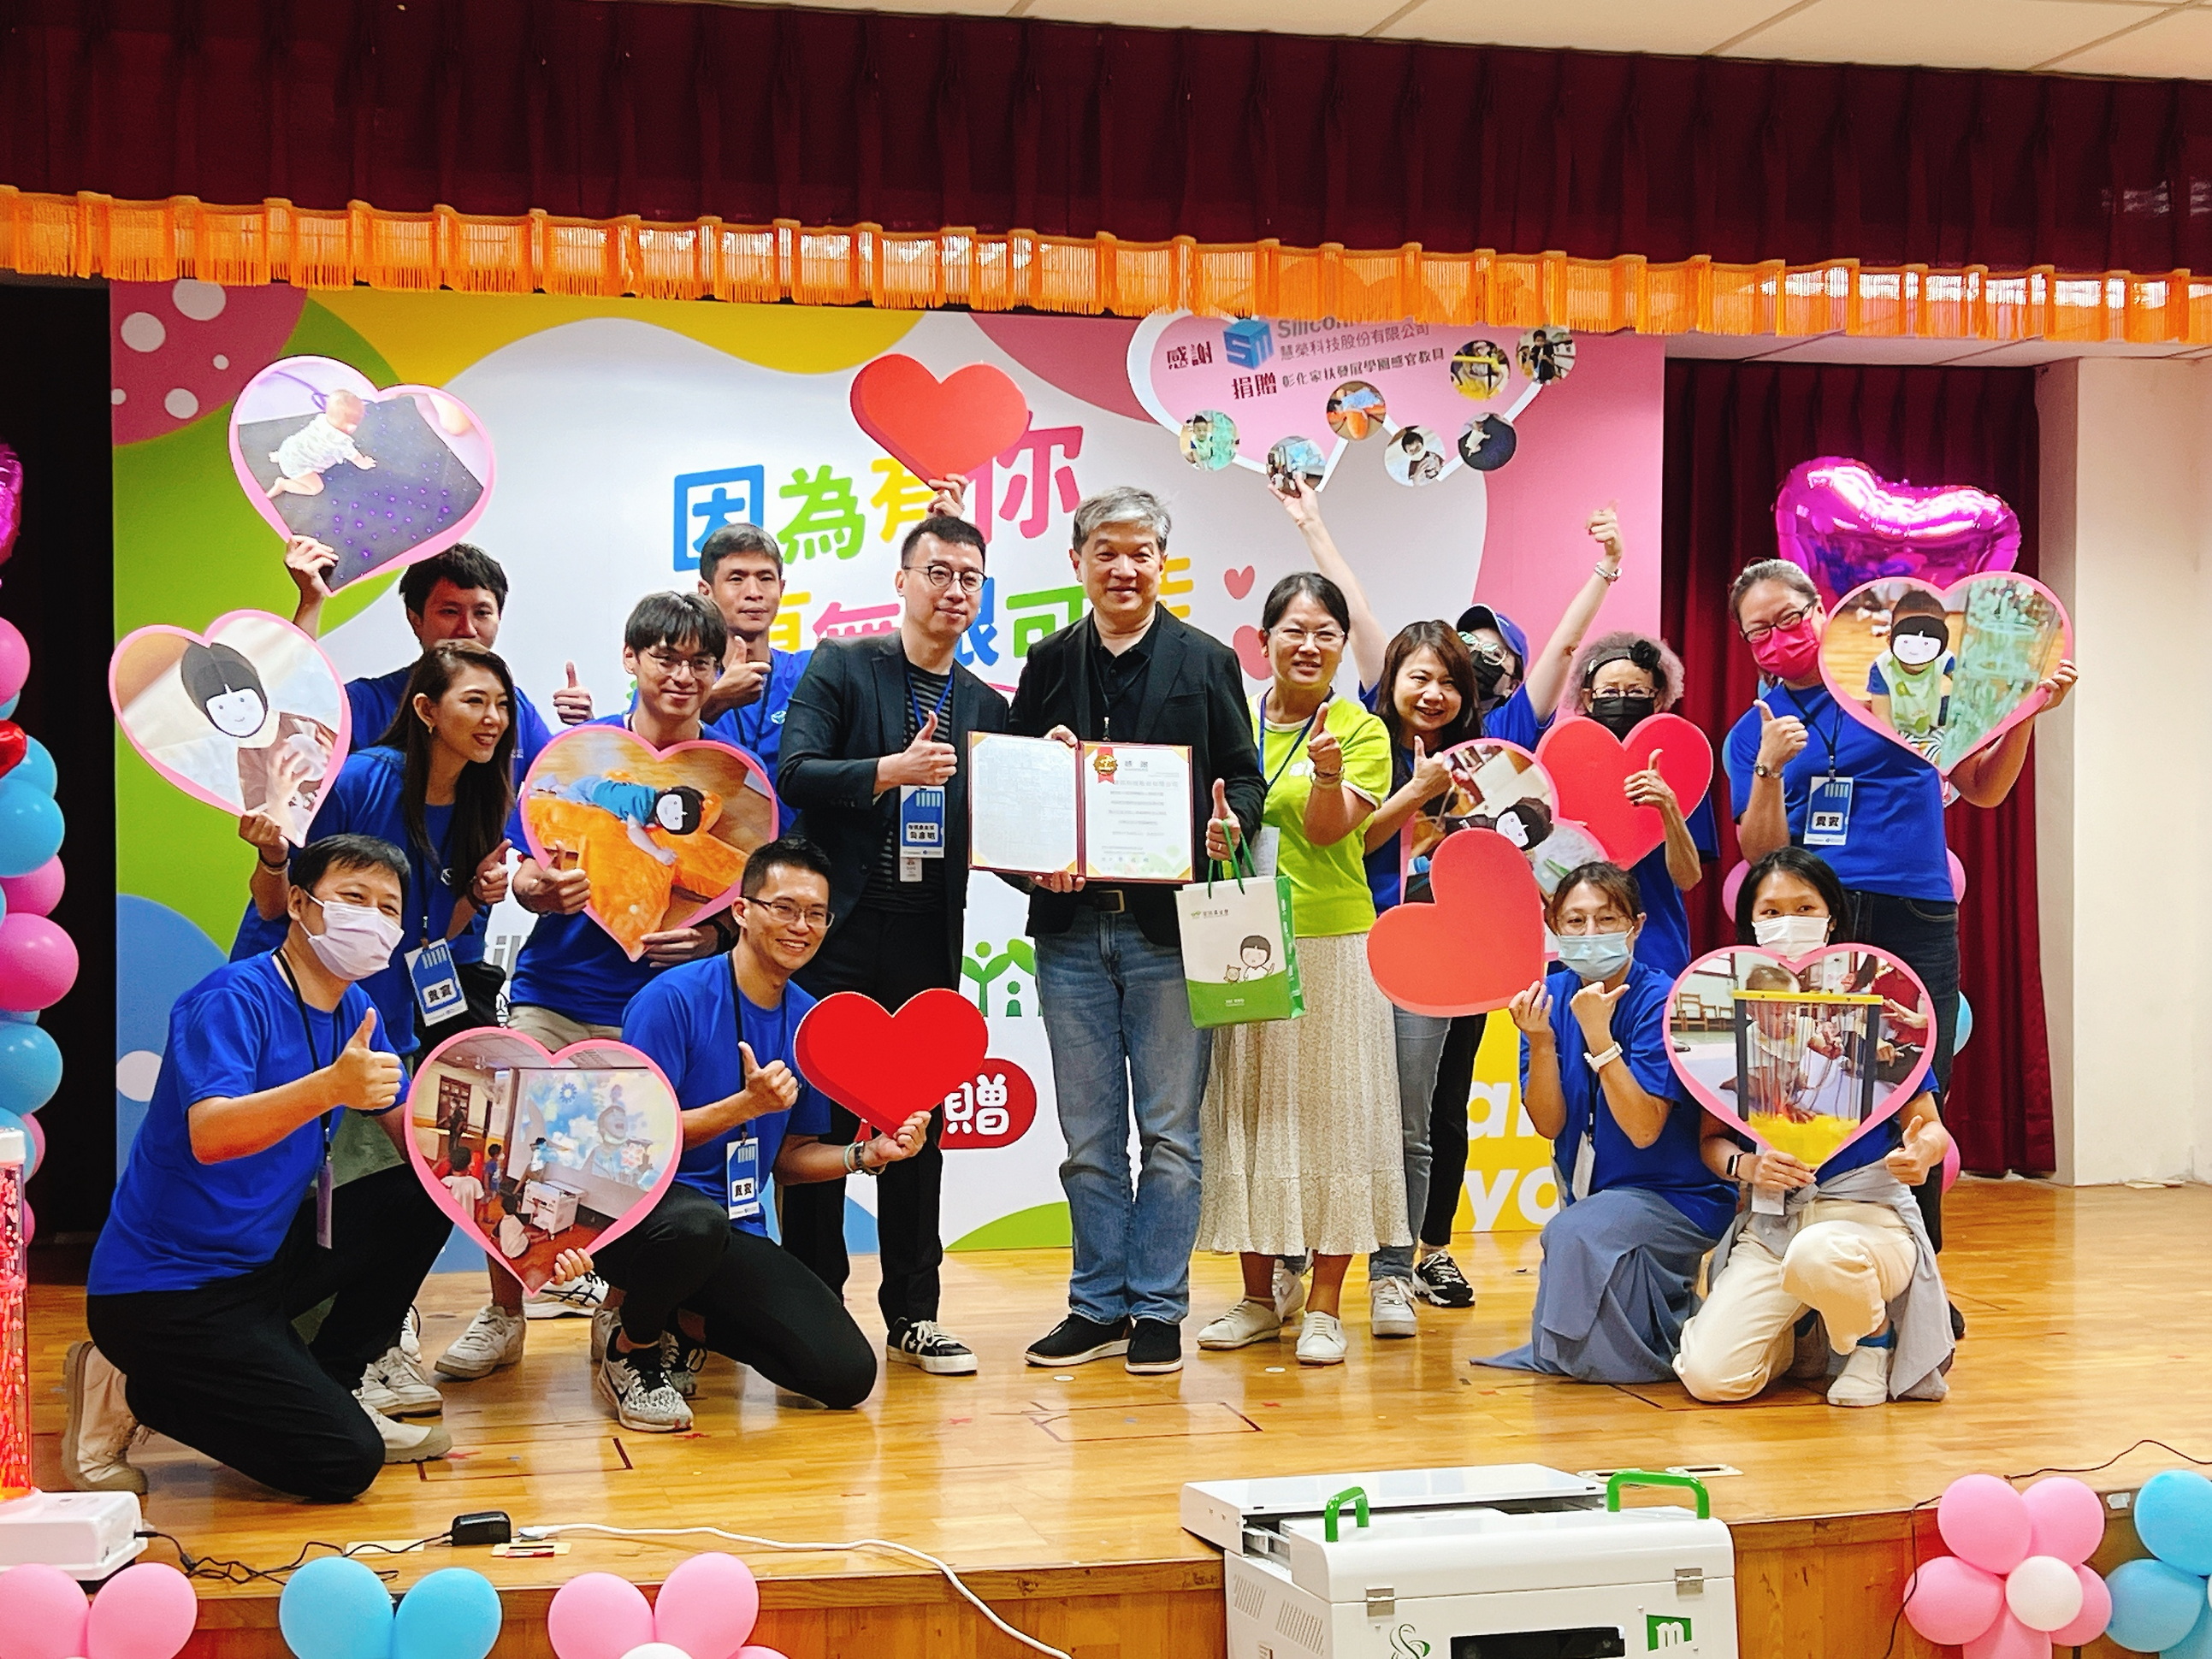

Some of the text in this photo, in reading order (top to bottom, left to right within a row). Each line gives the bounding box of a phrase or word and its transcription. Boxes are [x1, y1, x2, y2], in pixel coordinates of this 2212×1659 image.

[1166, 341, 1214, 370] 感謝
[1280, 322, 1430, 361] 慧榮科技股份有限公司
[1231, 372, 1277, 400] 捐贈
